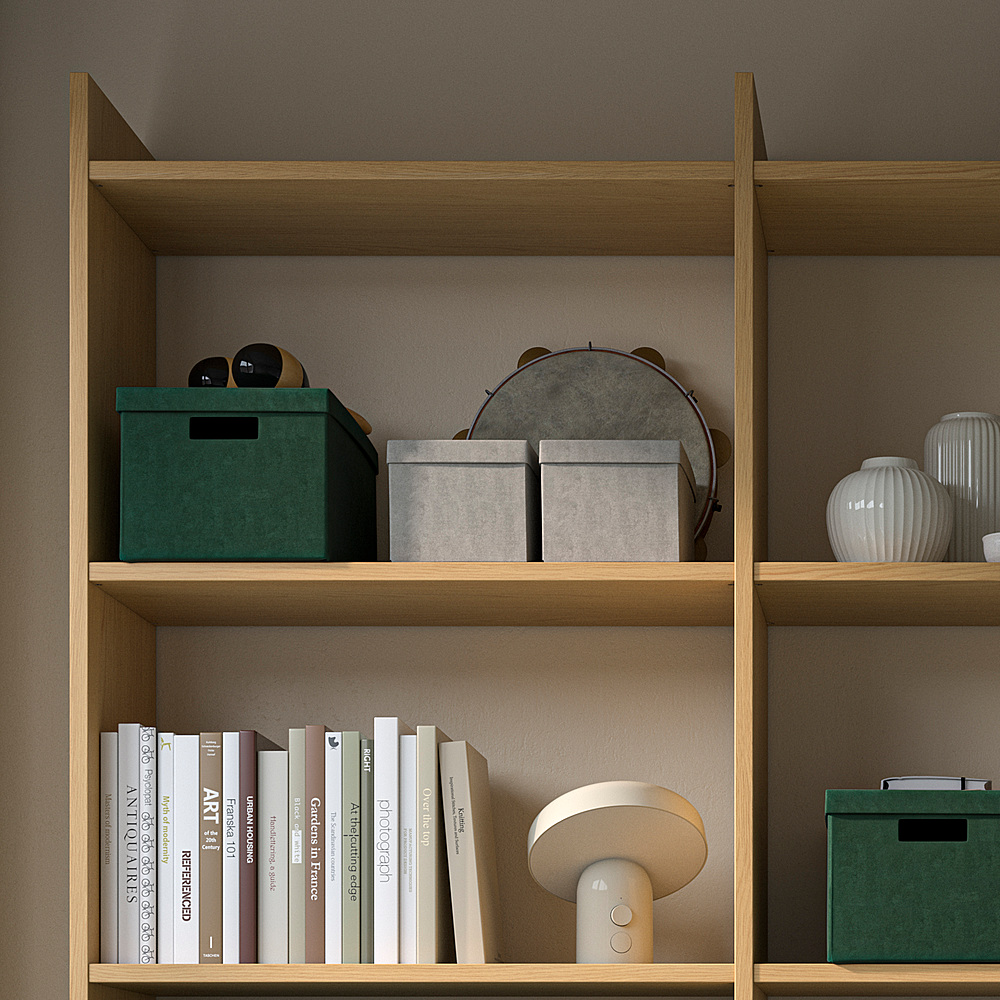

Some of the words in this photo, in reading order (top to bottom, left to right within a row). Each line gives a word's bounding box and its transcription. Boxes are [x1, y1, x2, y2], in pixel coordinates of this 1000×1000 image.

[104, 793, 112, 819] Masters
[161, 795, 170, 815] Myth
[203, 787, 219, 824] ART
[350, 802, 360, 816] At
[423, 788, 432, 811] Over
[162, 816, 170, 824] of
[226, 798, 236, 838] Franska
[310, 797, 321, 845] Gardens
[350, 818, 360, 834] the
[423, 813, 432, 829] the
[104, 829, 112, 865] modernism
[124, 785, 138, 904] ANTIQUAIRES
[161, 826, 170, 864] modernity
[226, 840, 236, 859] 101
[376, 799, 393, 883] photograph
[420, 831, 430, 846] top
[310, 847, 321, 858] in
[348, 836, 360, 872] cutting
[182, 850, 192, 922] REFERENCED
[268, 871, 276, 892] guide
[310, 861, 321, 901] France
[348, 875, 360, 902] edge
